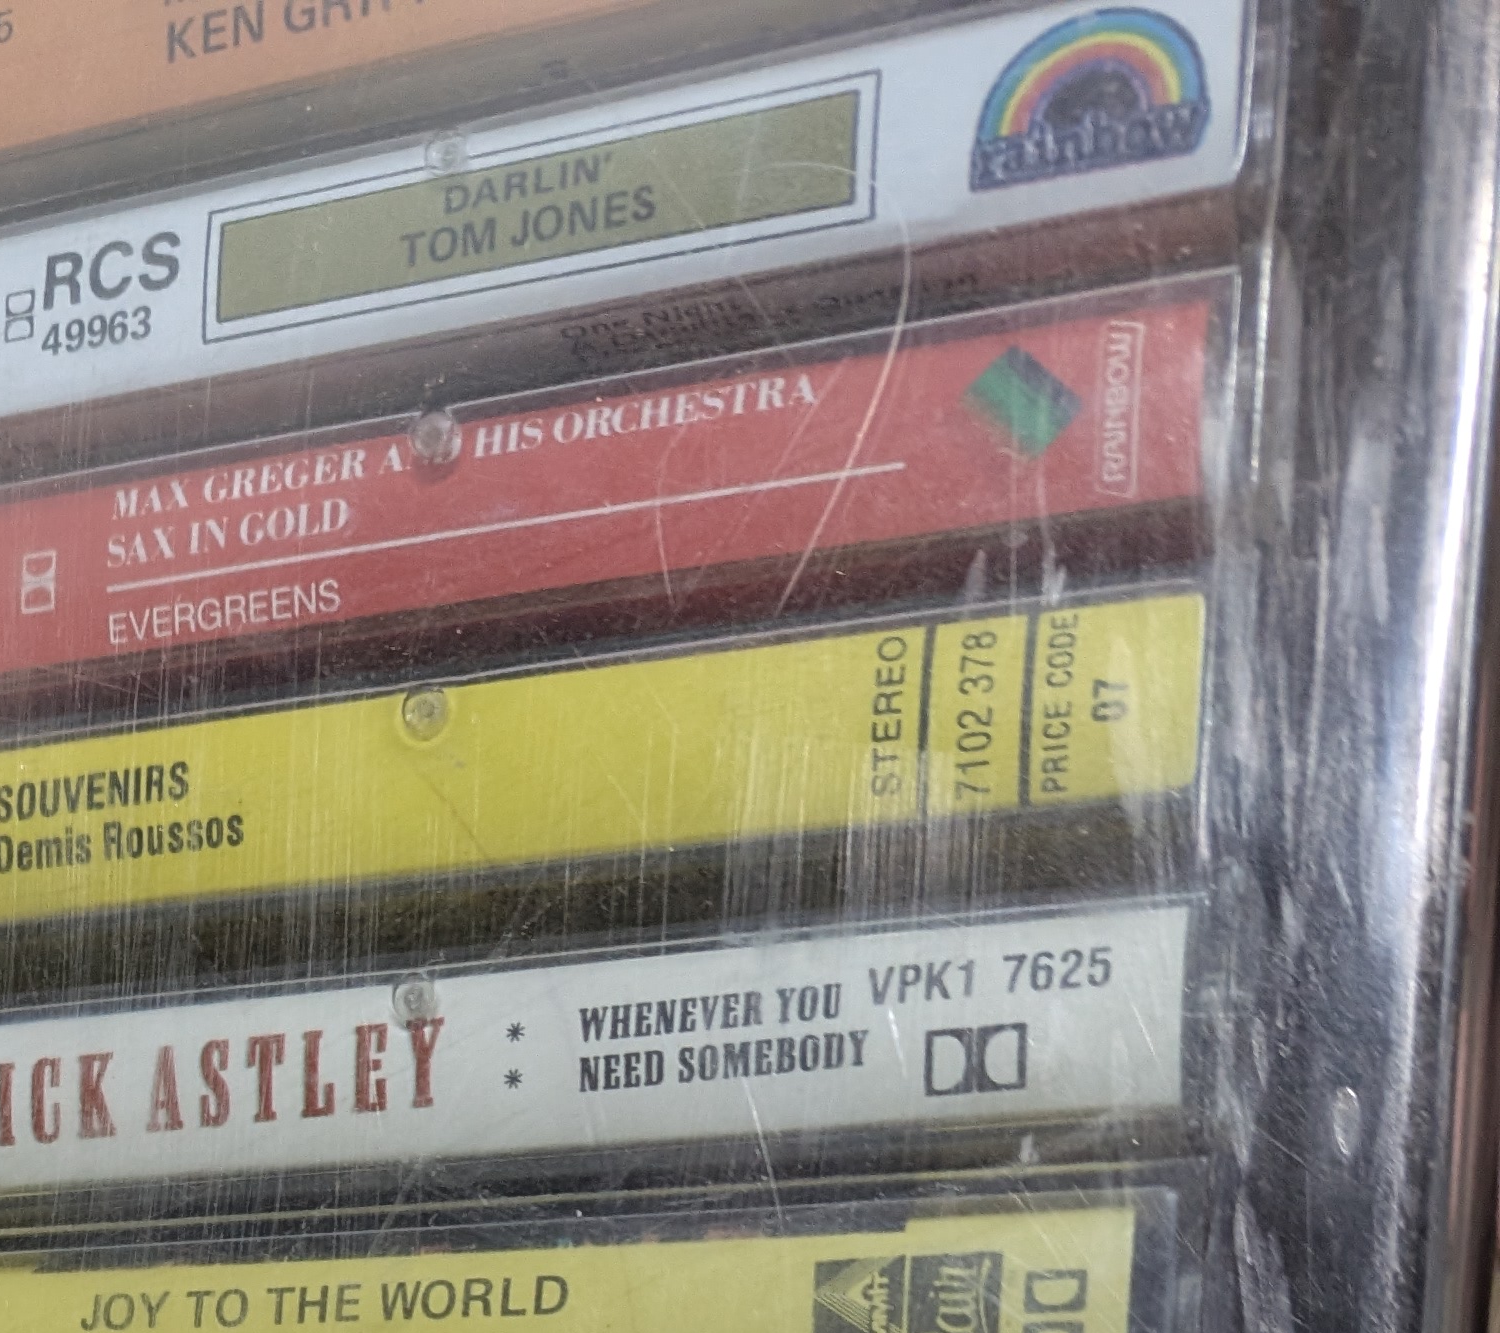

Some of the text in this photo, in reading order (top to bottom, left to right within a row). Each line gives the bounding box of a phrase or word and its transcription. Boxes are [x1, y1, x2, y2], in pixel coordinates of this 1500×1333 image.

[401, 185, 656, 268] TOM JONES
[42, 230, 181, 311] RCS
[40, 305, 151, 358] 49963
[188, 518, 231, 556] IN
[1041, 611, 1081, 795] PRICE CODE
[102, 813, 245, 866] Roussos
[1003, 947, 1113, 994] 7625
[578, 981, 843, 1043] WHENEVER YOU
[145, 1017, 444, 1134] ASTLEY
[578, 1030, 870, 1093] NEED SOMEBODY
[80, 1274, 569, 1333] JOY TO THE WORLD
